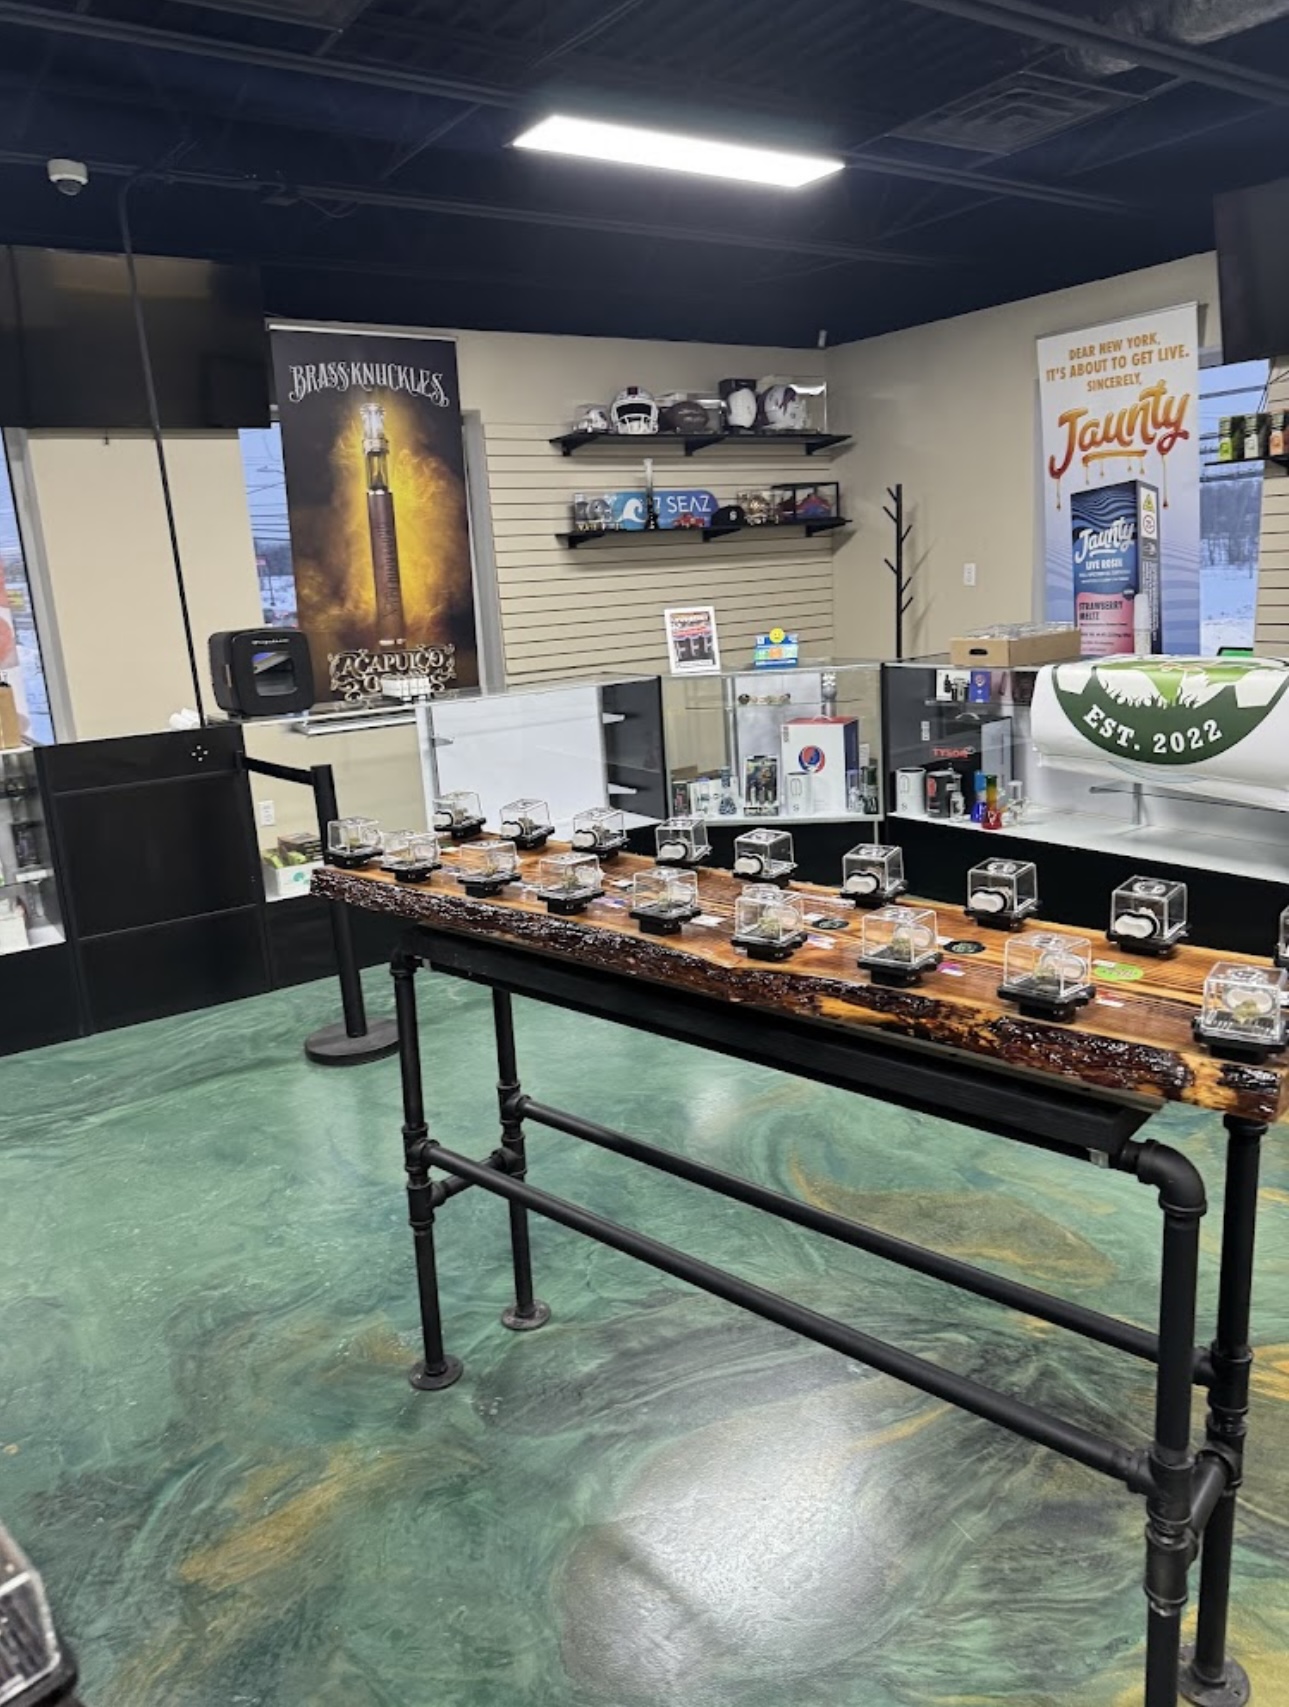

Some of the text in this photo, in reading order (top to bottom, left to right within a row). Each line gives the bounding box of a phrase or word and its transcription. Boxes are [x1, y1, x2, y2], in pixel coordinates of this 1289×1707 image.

[1046, 344, 1190, 382] IT'S ABOUT TO GET LIVE.
[1069, 344, 1096, 361] DEAR
[1099, 339, 1123, 355] NEW
[350, 362, 450, 408] KNUCKLES
[1087, 372, 1142, 392] SINCERELY,
[1048, 379, 1191, 480] Jaunty
[667, 495, 712, 514] SEAZ
[1075, 516, 1135, 564] Jaunty
[1085, 559, 1101, 571] LIVE
[1078, 600, 1124, 612] STRAWBERRY
[1082, 703, 1223, 753] EST. 2022
